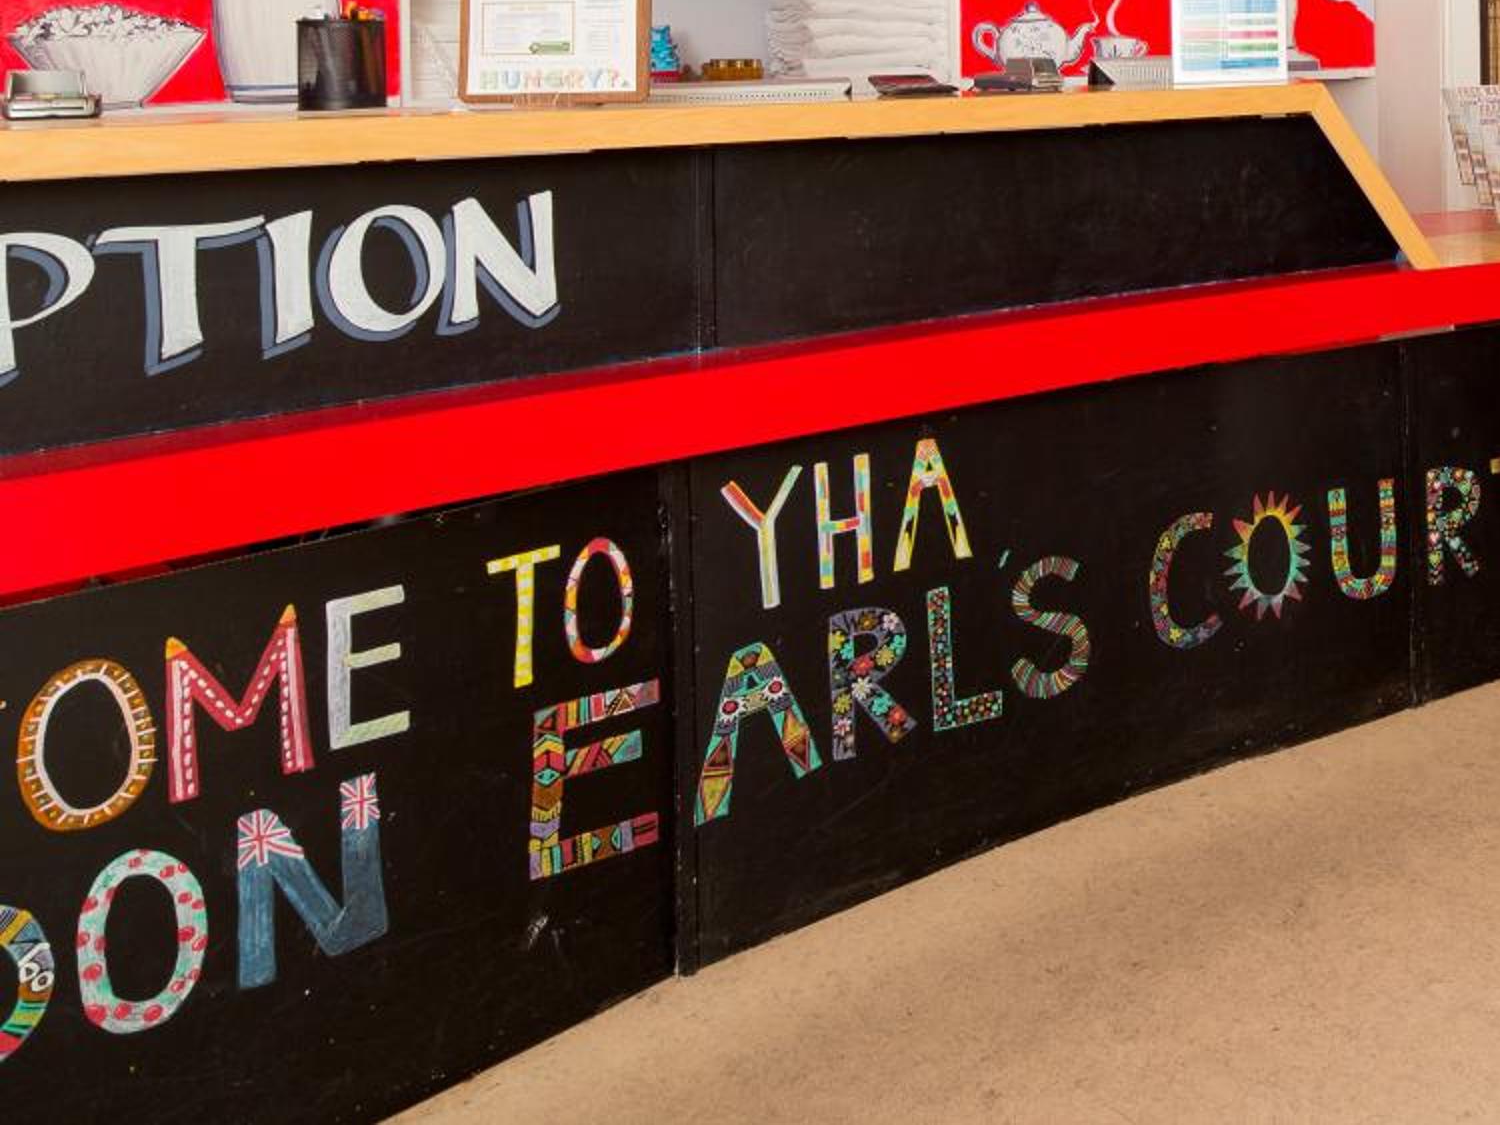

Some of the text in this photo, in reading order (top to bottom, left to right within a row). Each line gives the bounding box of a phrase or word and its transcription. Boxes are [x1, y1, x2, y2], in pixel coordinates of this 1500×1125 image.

[487, 536, 634, 689] TO
[720, 437, 973, 610] YHA
[529, 548, 1092, 882] EARL'S
